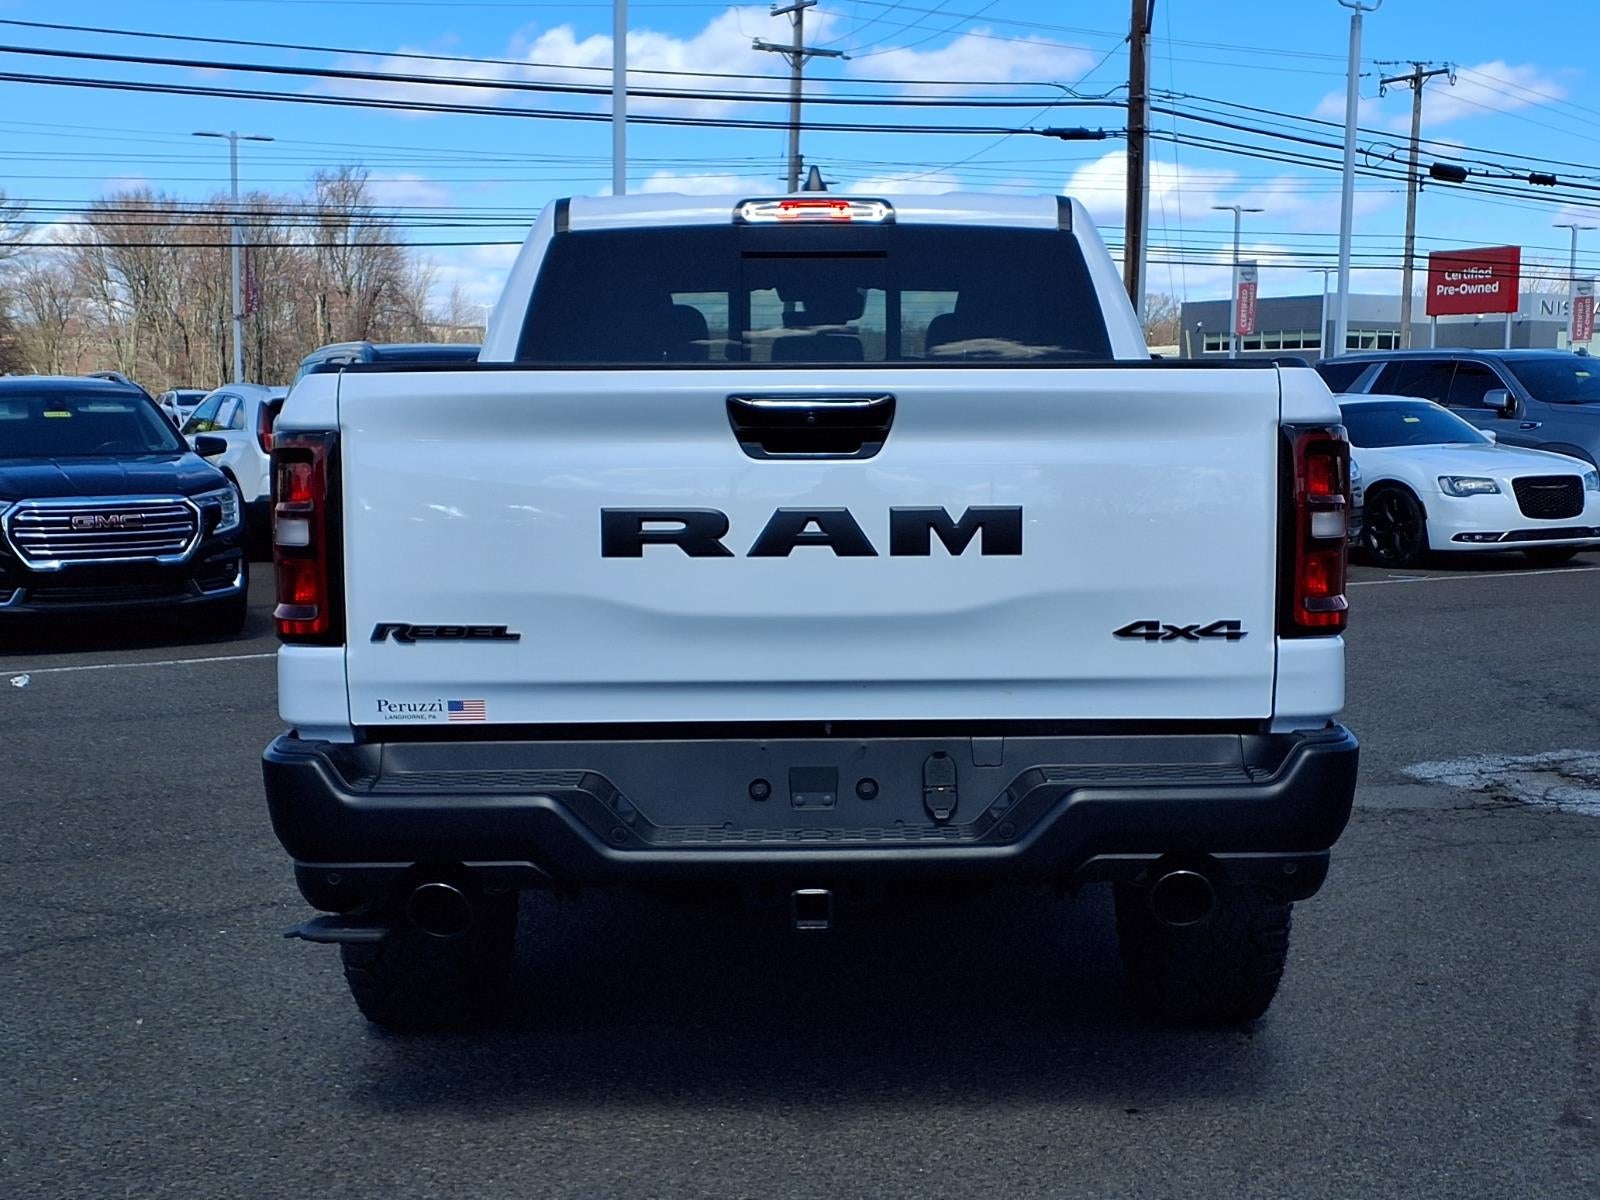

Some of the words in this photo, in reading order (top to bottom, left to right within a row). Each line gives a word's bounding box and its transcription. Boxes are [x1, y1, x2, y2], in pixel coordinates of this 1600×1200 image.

[1444, 266, 1493, 281] Certified
[1436, 281, 1500, 296] Pre-Owned
[71, 514, 142, 530] GMC
[600, 506, 1023, 557] RAM
[370, 622, 521, 644] REBEL
[1112, 620, 1249, 642] 4x4
[376, 698, 443, 713] Peruzzi
